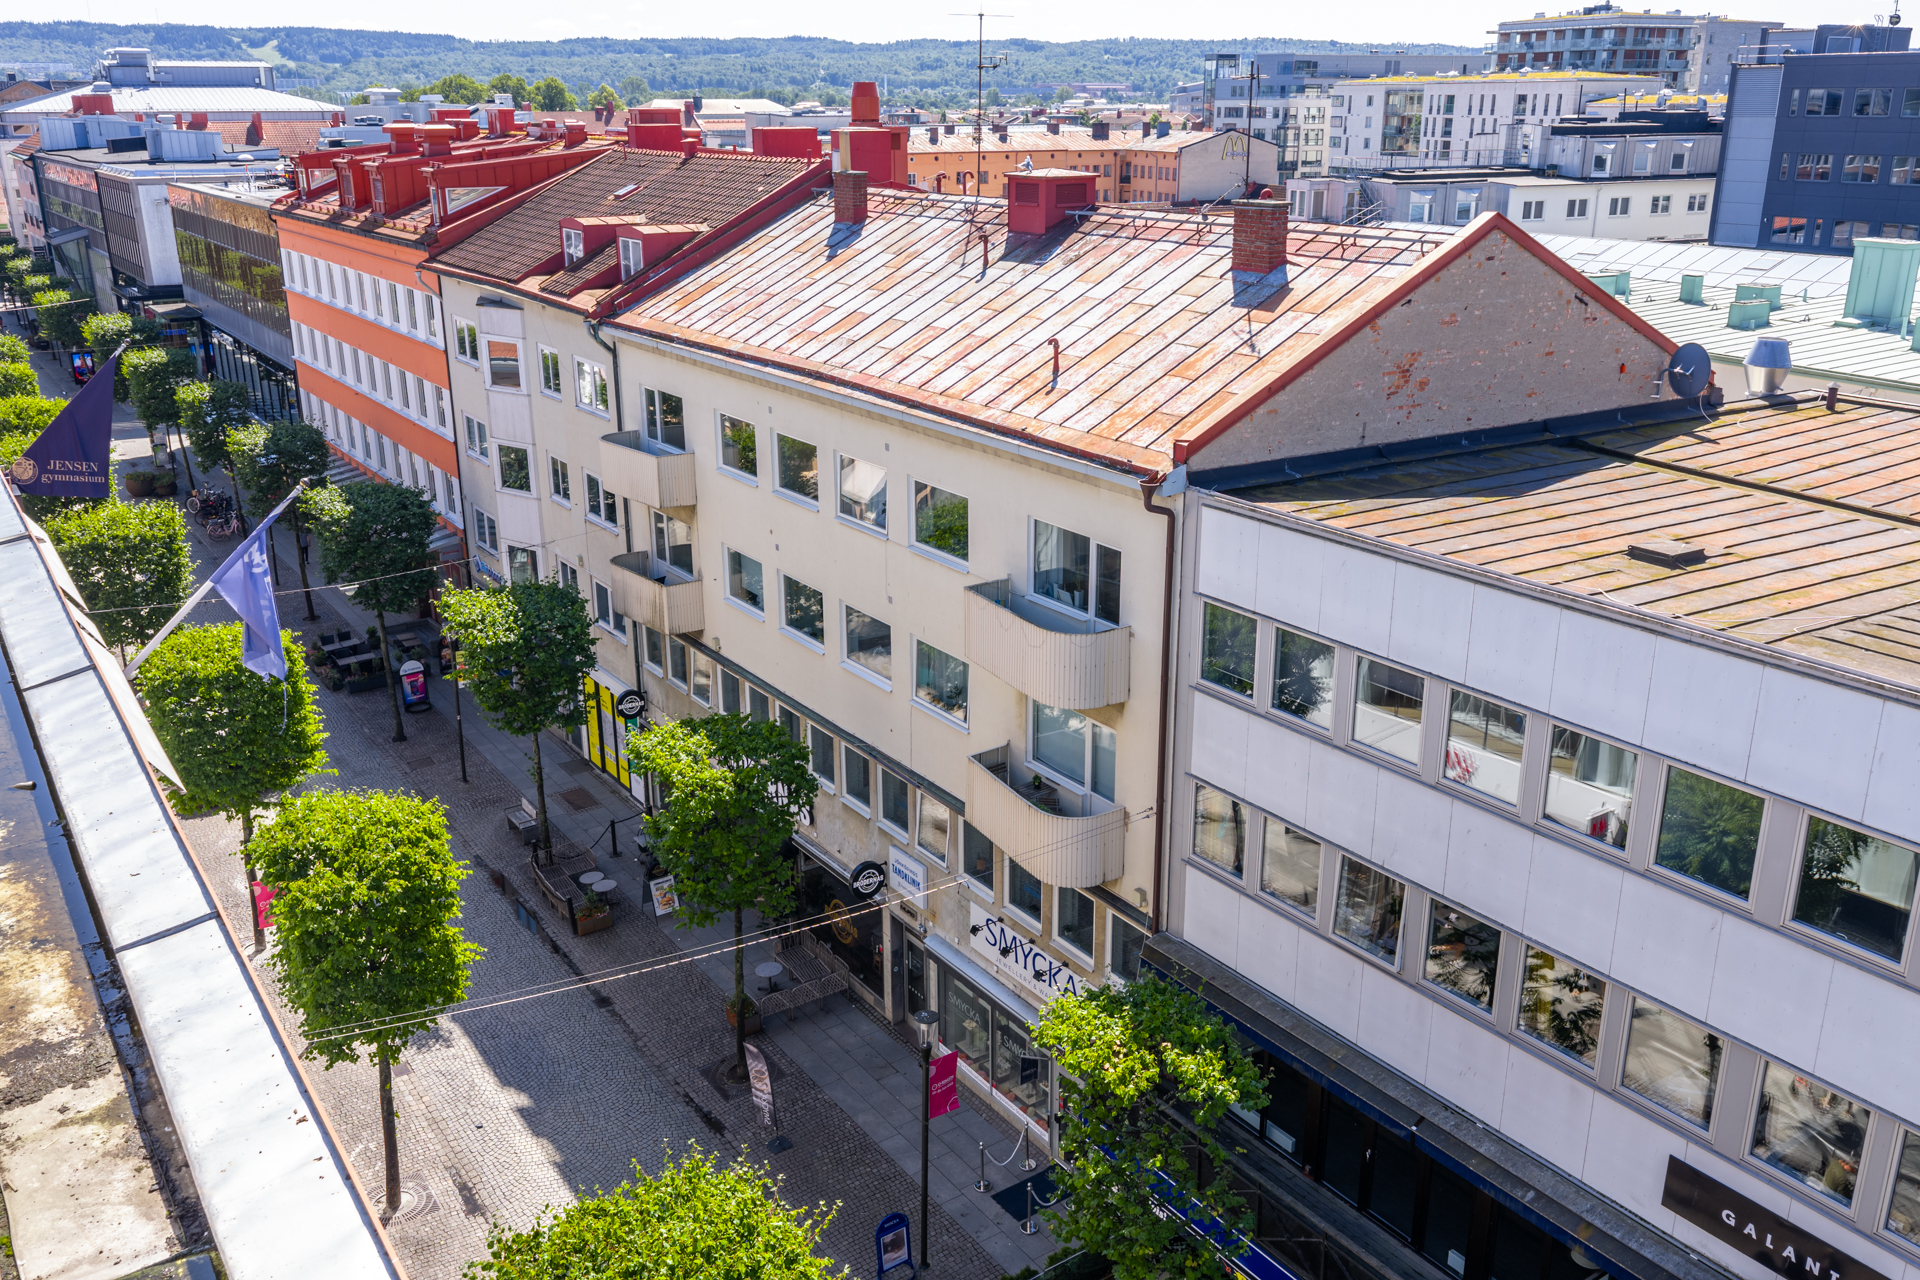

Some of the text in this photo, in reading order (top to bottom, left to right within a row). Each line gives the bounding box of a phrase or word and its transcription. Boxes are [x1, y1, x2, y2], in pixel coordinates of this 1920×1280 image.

[41, 473, 105, 484] gymnasium
[47, 460, 98, 472] JENSEN
[892, 863, 920, 892] TANDKLINIK
[985, 918, 1077, 997] SMYCKA
[996, 956, 1031, 985] JEWELLERY
[948, 991, 981, 1026] SMYCKA
